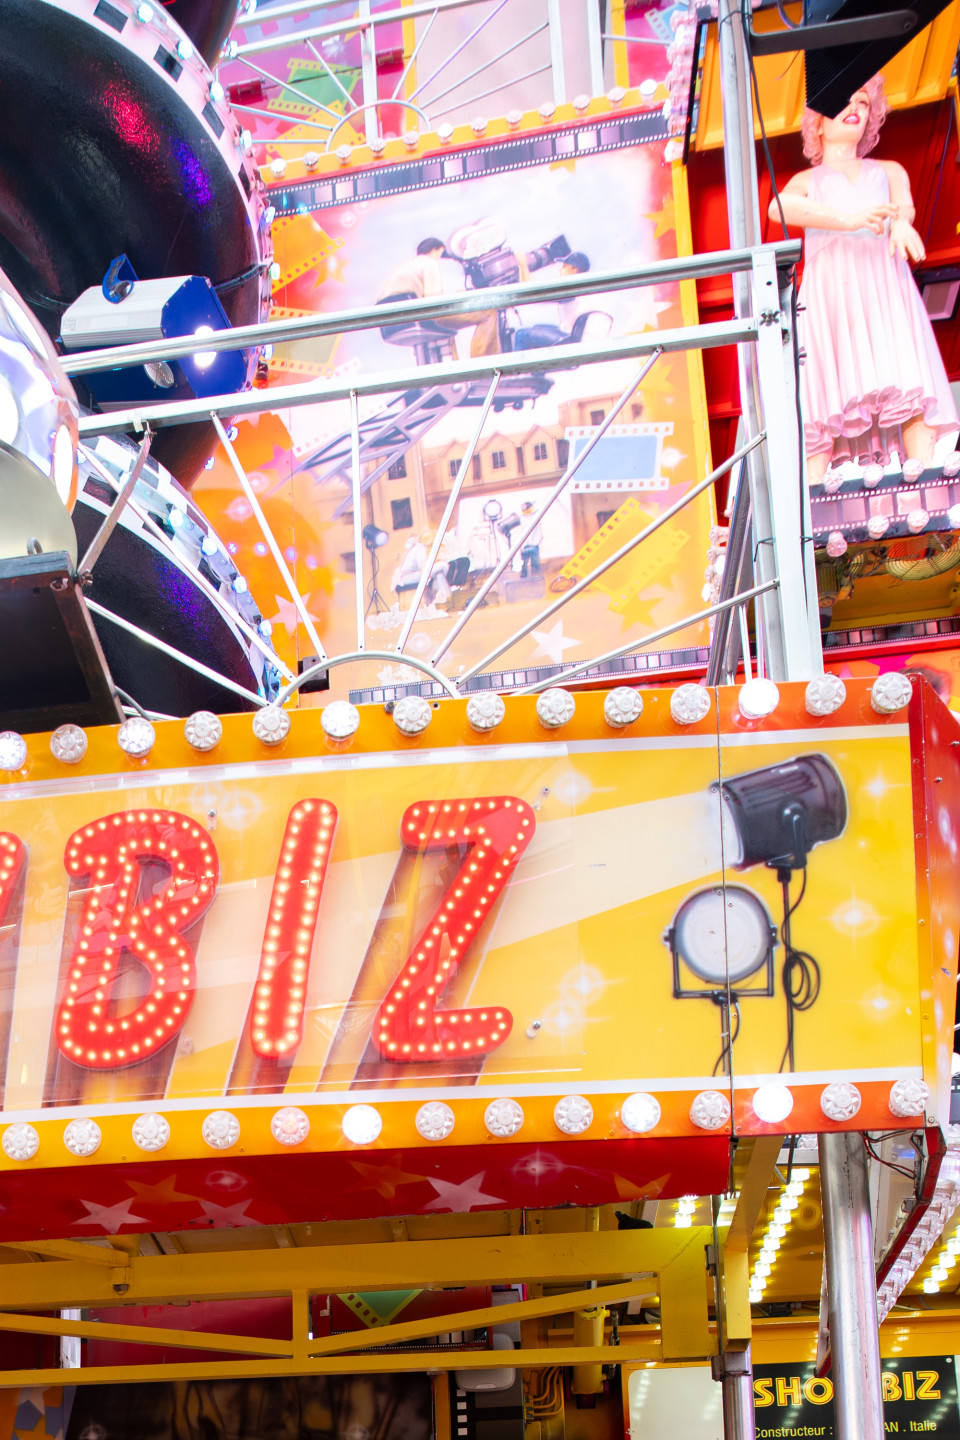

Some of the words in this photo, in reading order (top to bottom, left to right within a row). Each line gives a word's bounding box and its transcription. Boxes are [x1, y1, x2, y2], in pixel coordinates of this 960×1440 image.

[753, 1371, 941, 1407] SHOBIZ
[755, 1426, 826, 1438] Constructeur
[909, 1420, 937, 1432] Italie
